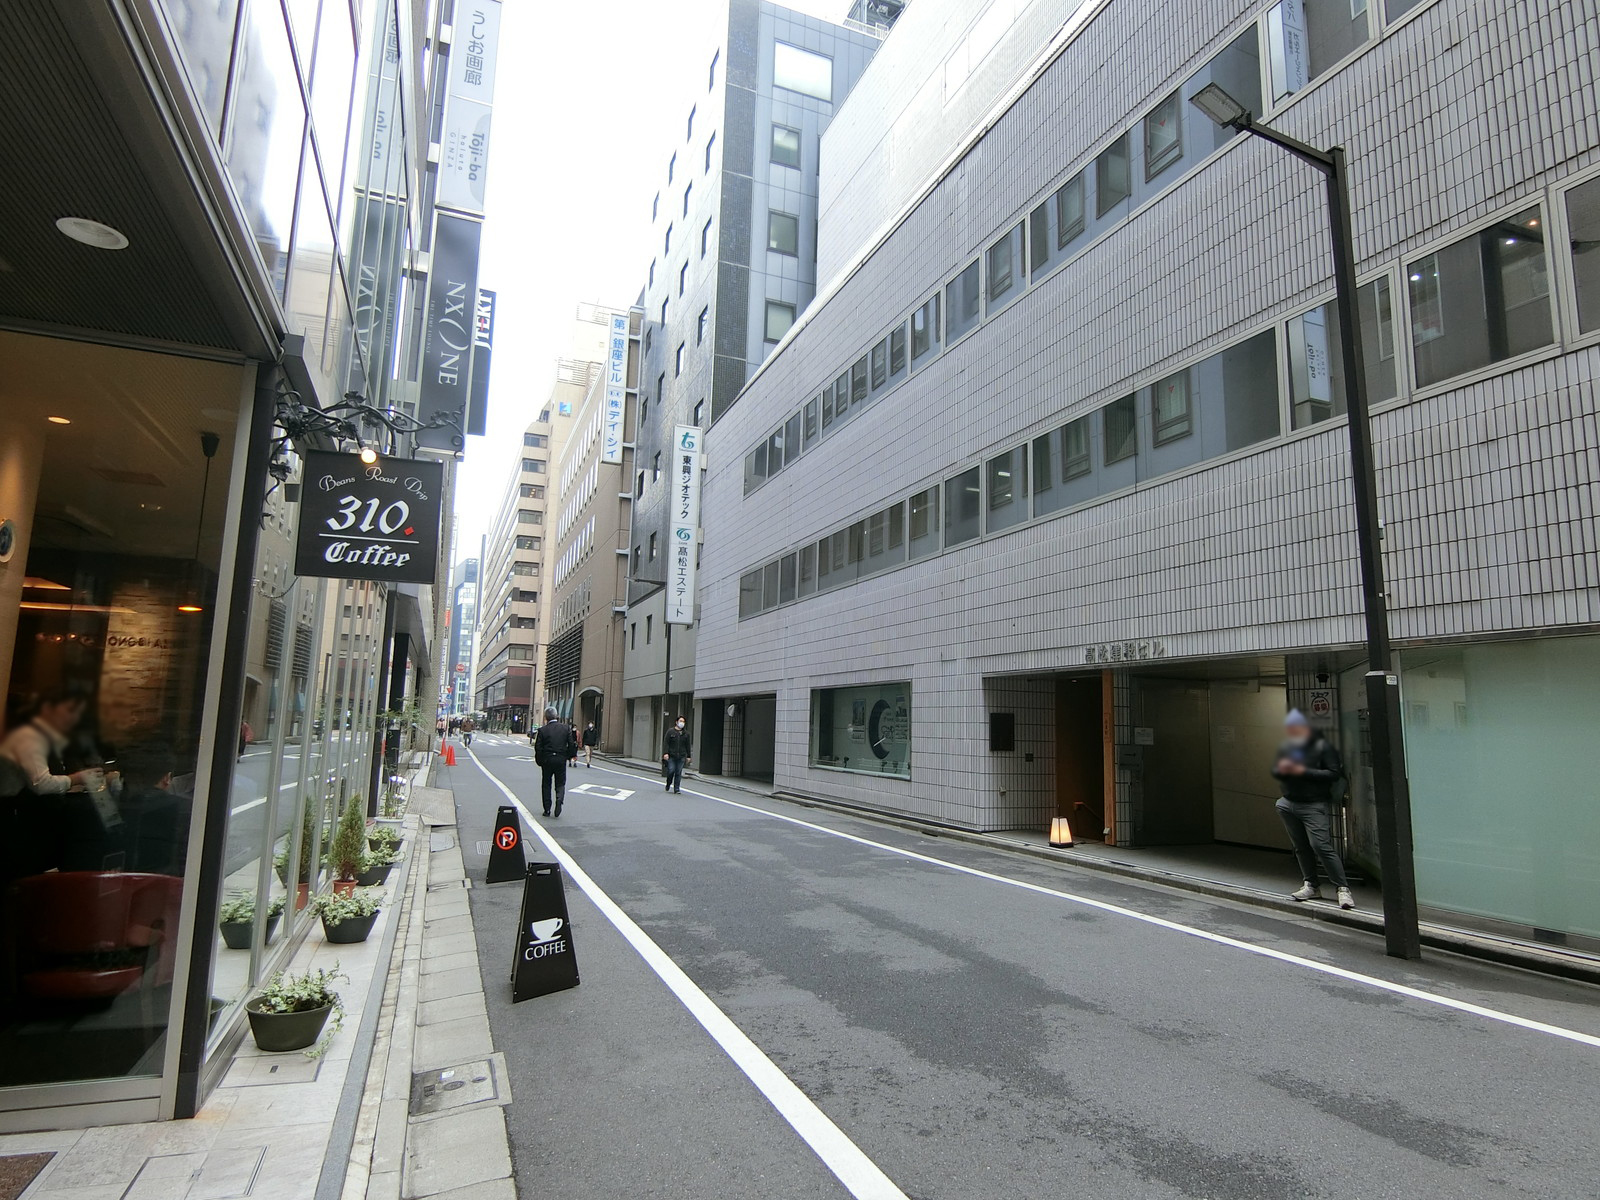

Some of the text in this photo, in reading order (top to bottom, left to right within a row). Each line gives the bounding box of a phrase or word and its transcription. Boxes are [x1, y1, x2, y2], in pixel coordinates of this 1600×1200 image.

[464, 10, 485, 86] うしお画廊
[475, 291, 493, 351] JTEKT
[610, 318, 626, 384] 第一銀座ビル
[319, 466, 428, 501] Beans Roast Drip
[680, 455, 692, 519] 東興ジオテック
[325, 541, 411, 567] Coffee
[524, 940, 567, 961] COFFEE
